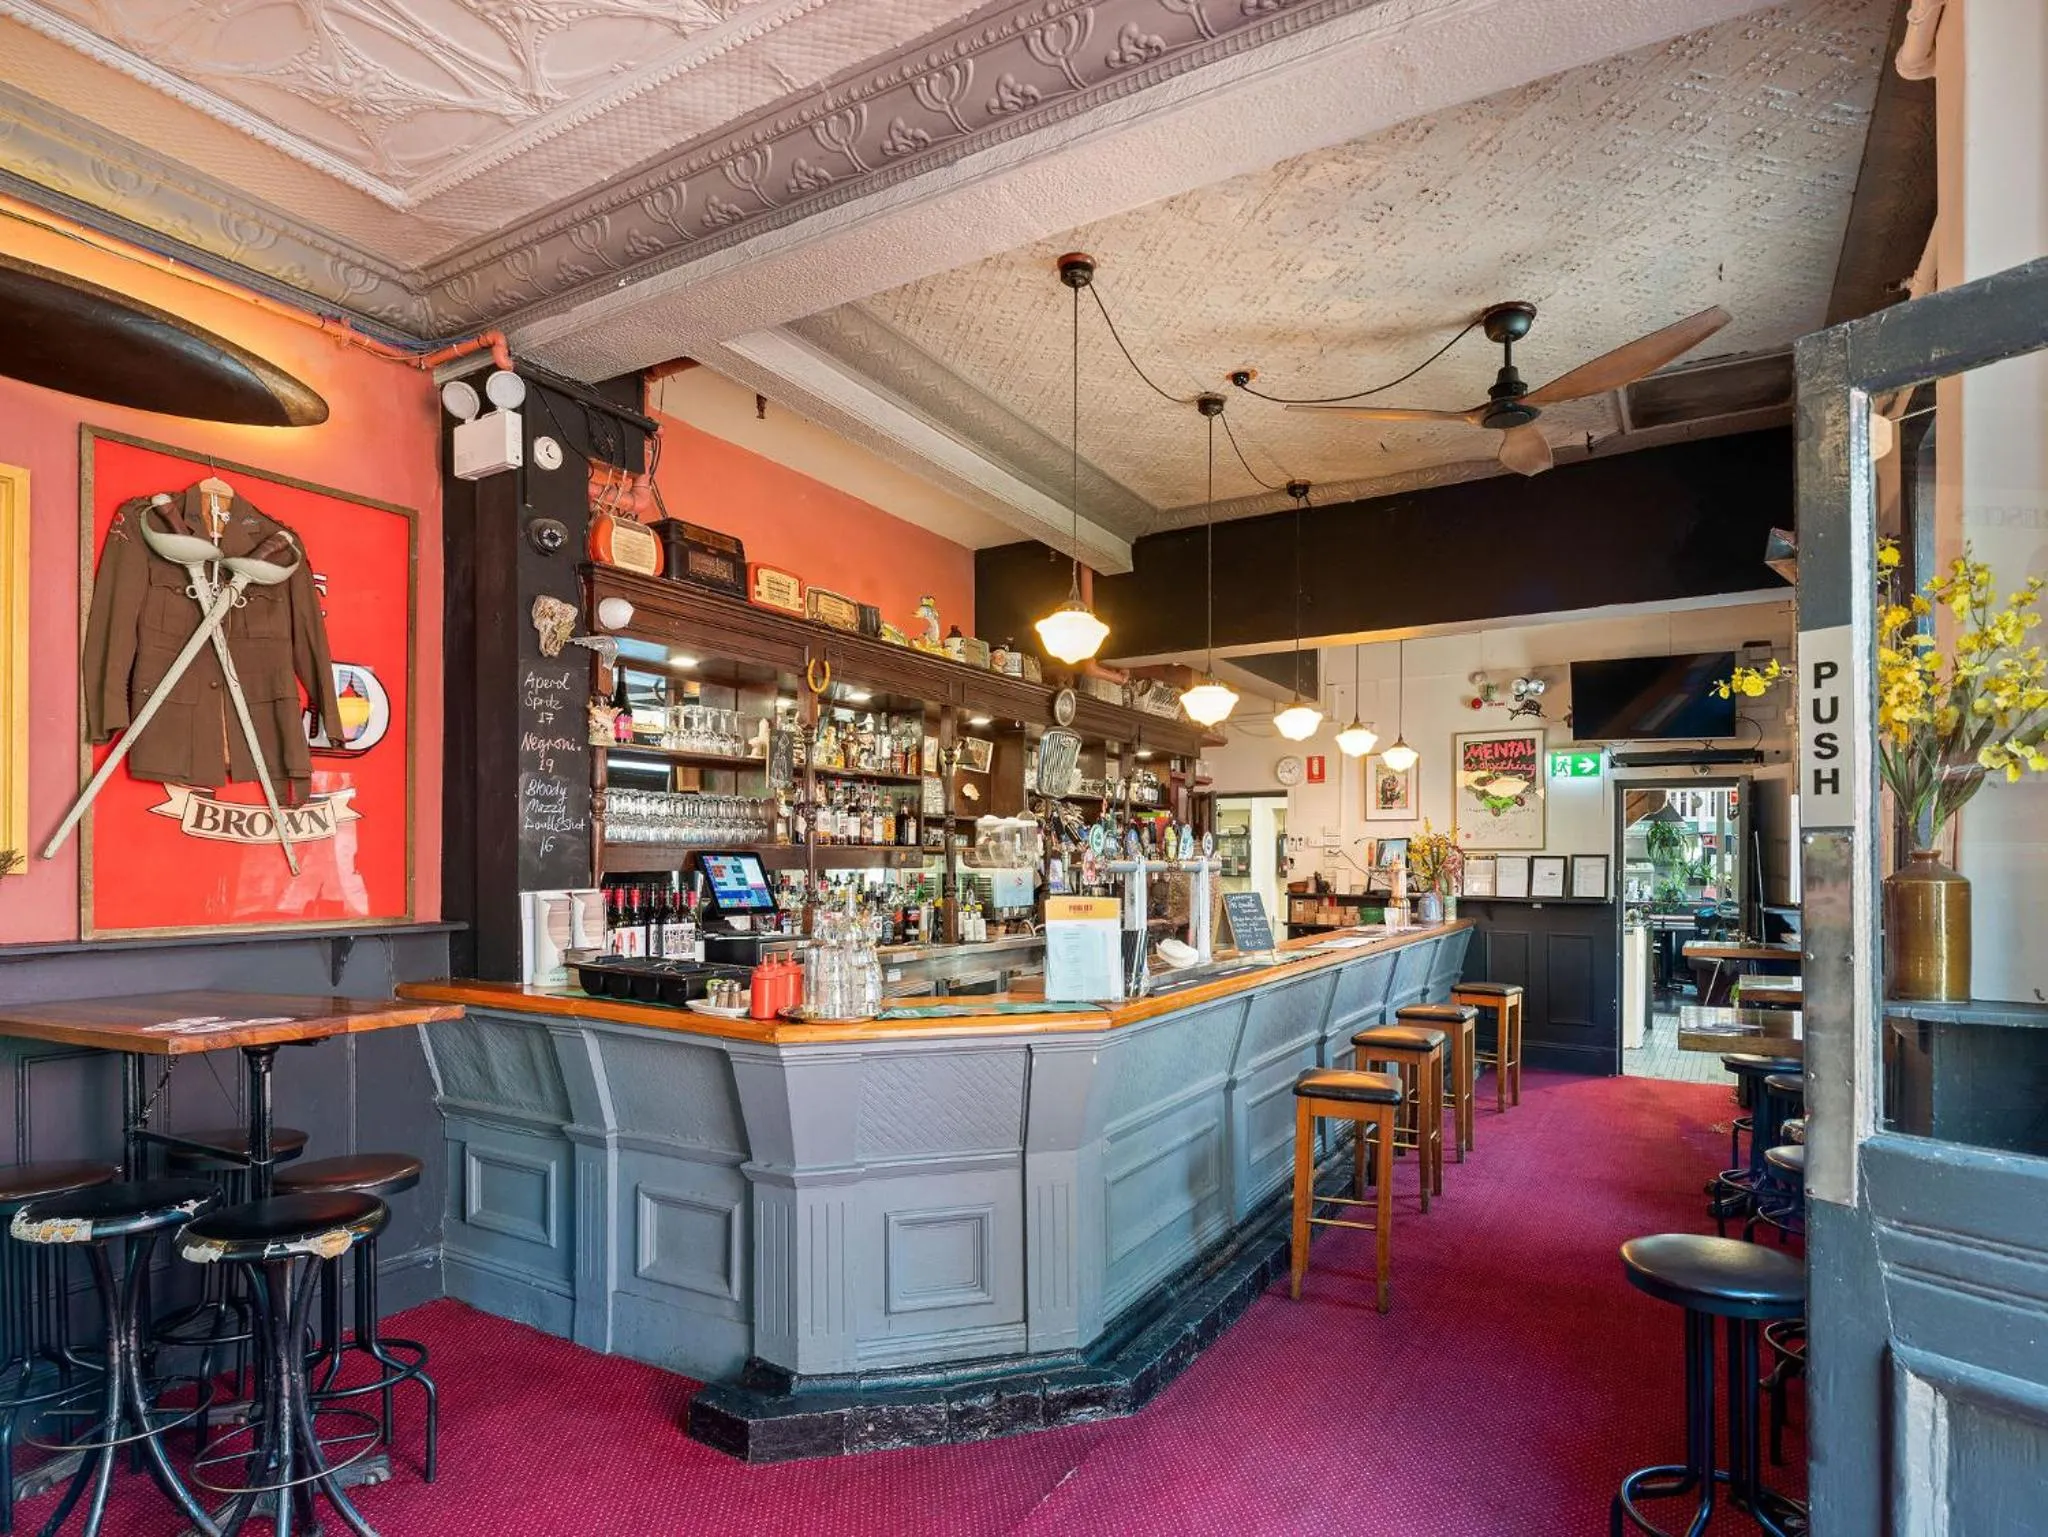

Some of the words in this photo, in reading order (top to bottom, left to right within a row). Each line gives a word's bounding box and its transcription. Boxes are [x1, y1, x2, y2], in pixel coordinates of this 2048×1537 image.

[523, 671, 571, 695] Aperol
[538, 711, 555, 725] 17
[1812, 661, 1840, 796] PUSH
[1464, 739, 1536, 761] MENTAL
[538, 758, 554, 773] 19
[524, 778, 568, 805] Bloody
[540, 835, 556, 859] 16
